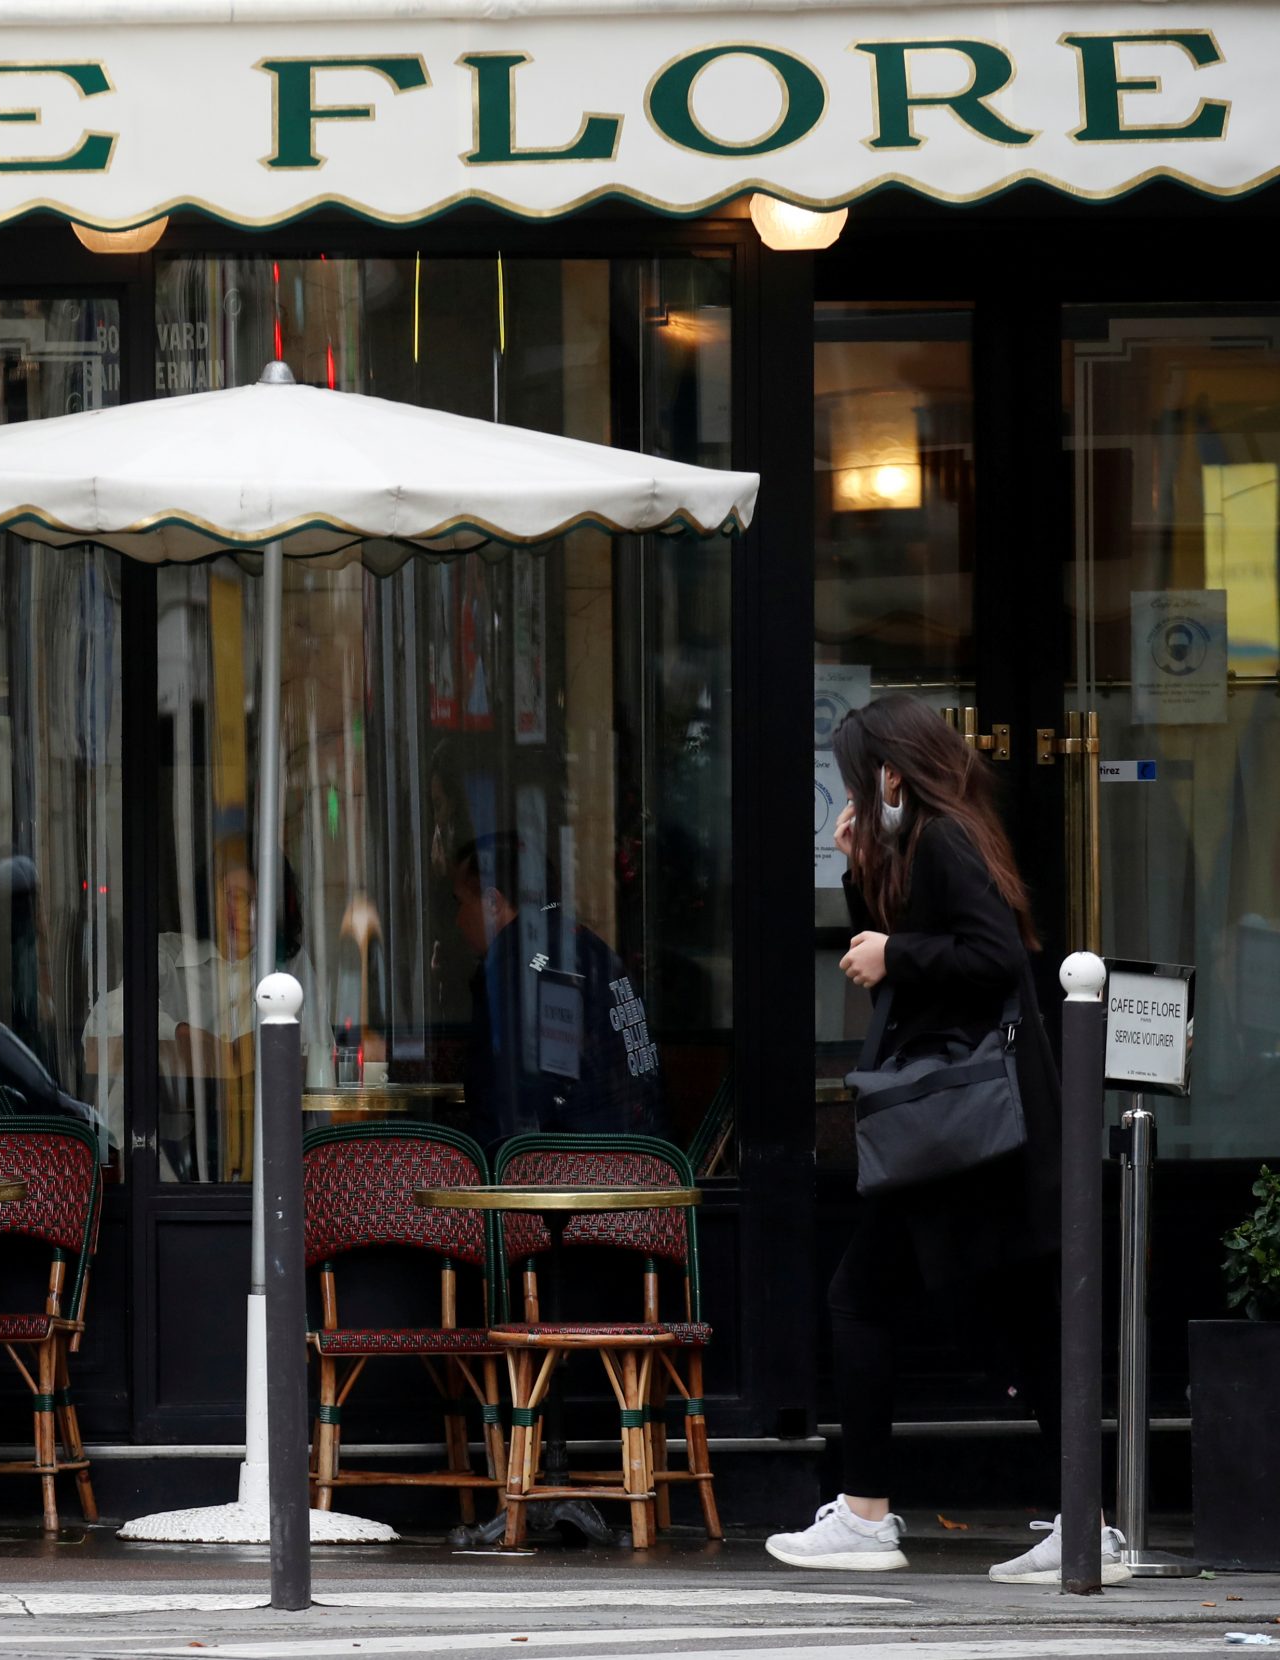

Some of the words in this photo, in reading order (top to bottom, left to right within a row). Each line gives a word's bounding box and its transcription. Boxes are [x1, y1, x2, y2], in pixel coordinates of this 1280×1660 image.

[251, 28, 1232, 172] FLORE
[1100, 766, 1120, 775] tirez
[609, 976, 634, 1004] THE
[609, 997, 646, 1031] GREEN
[1110, 997, 1134, 1014] CAFE
[1136, 1000, 1149, 1015] DE
[1151, 1001, 1181, 1018] FLORE
[622, 1021, 650, 1052] BLUE
[1115, 1029, 1141, 1045] SERVICE
[1142, 1032, 1174, 1047] VOITURIER
[627, 1043, 659, 1077] QUEST
